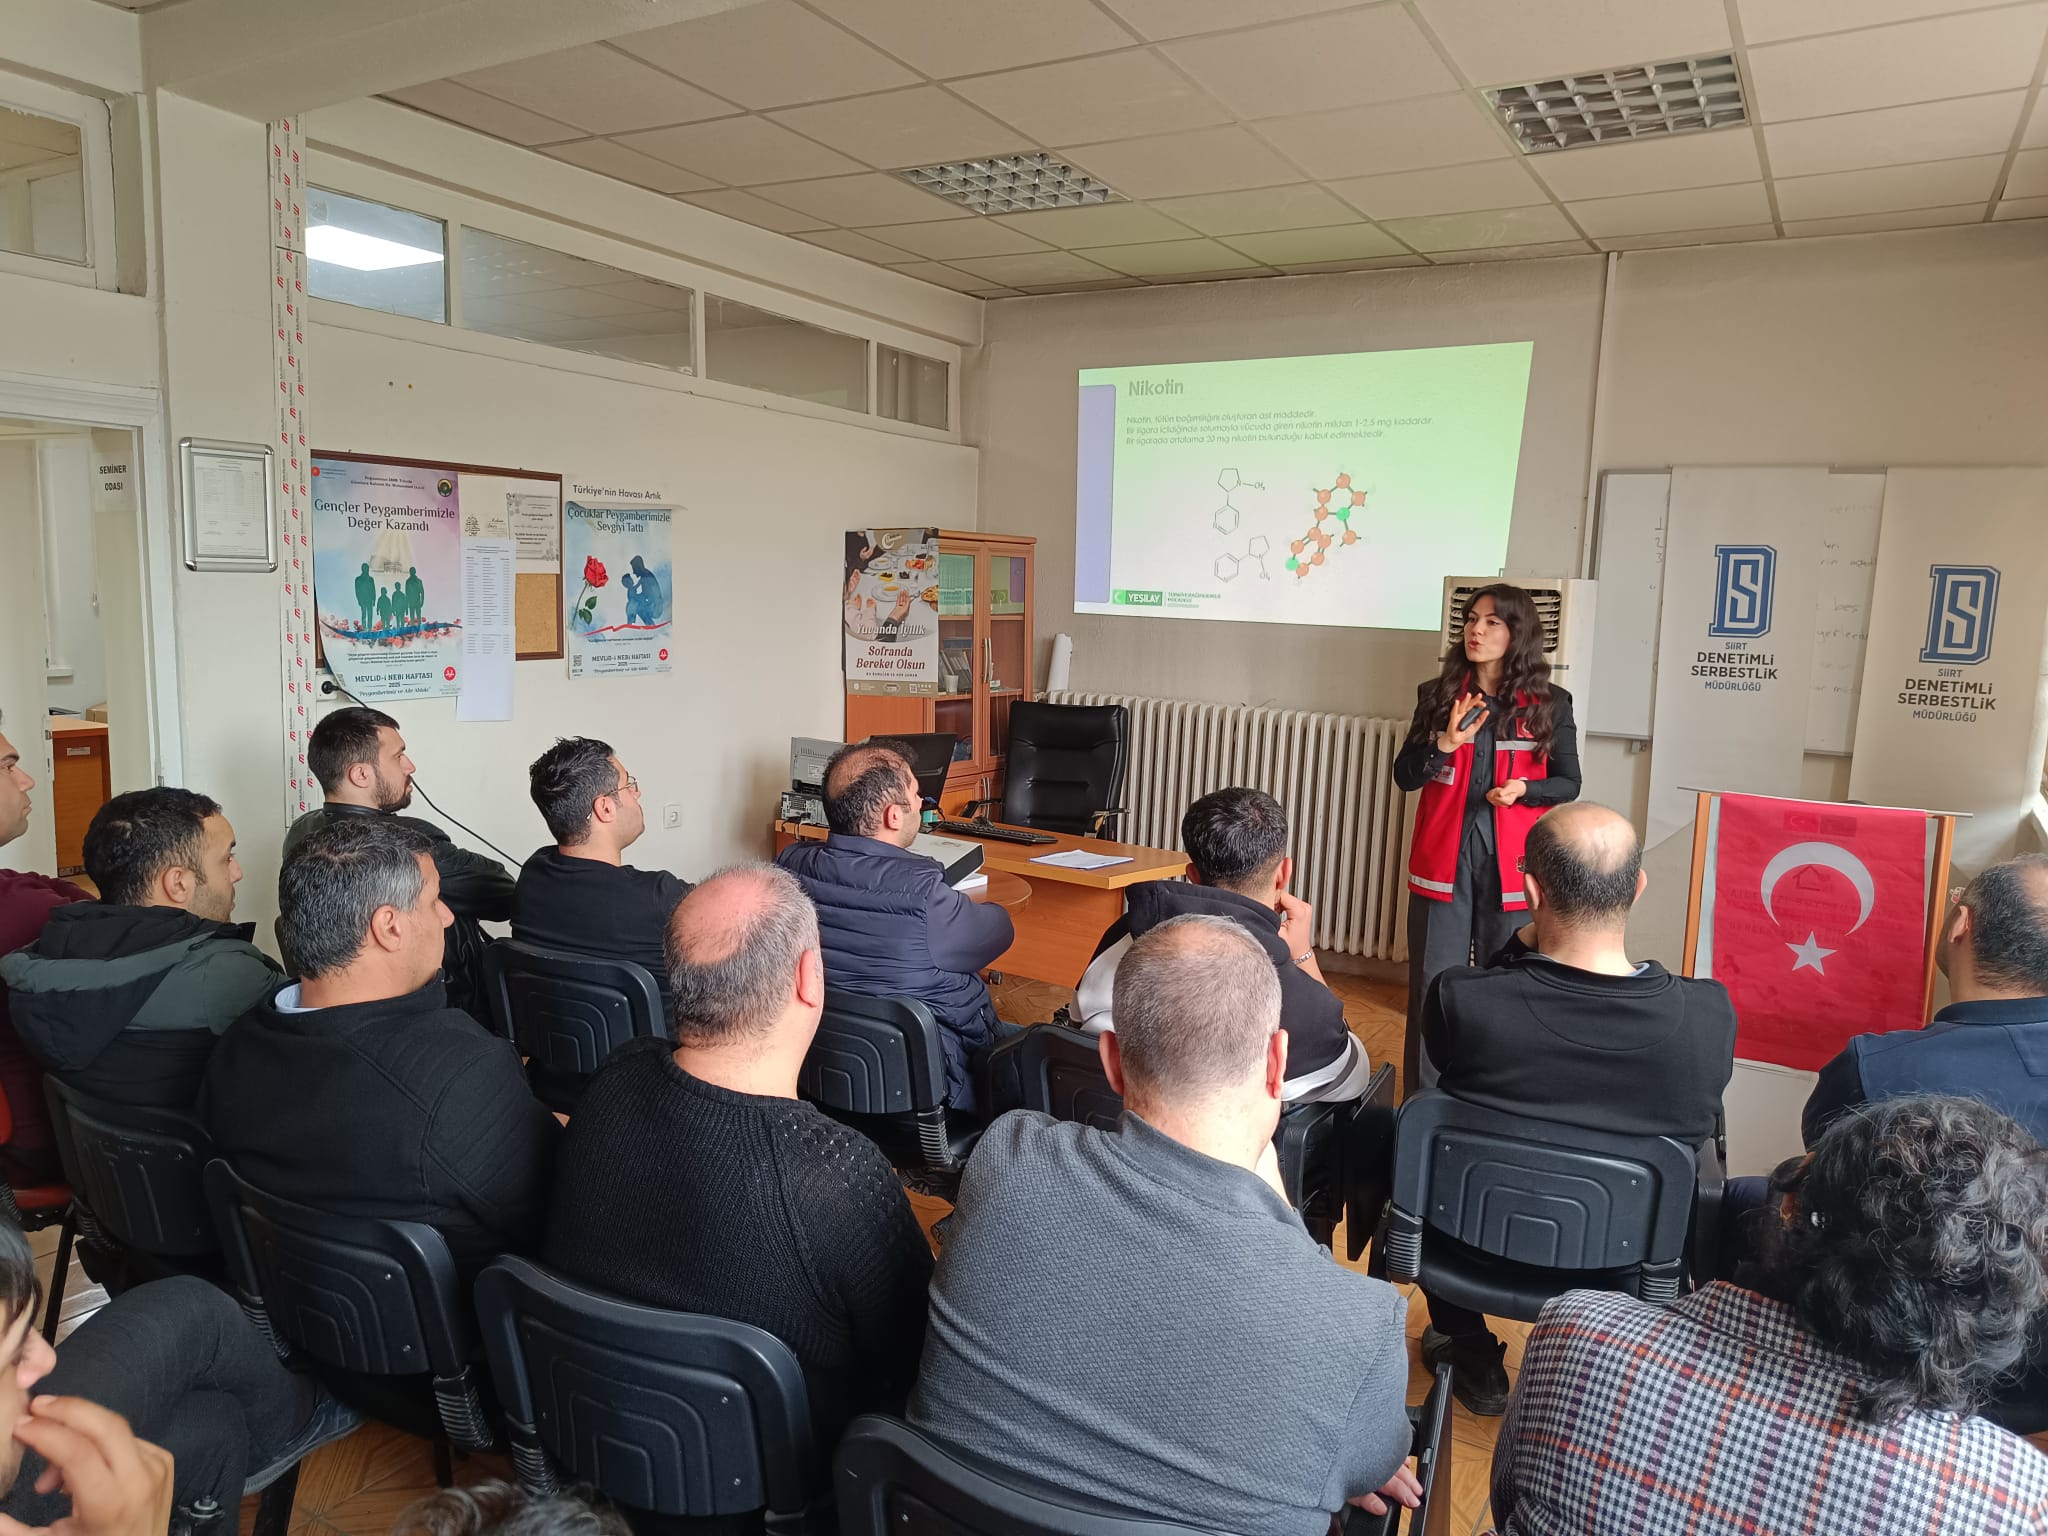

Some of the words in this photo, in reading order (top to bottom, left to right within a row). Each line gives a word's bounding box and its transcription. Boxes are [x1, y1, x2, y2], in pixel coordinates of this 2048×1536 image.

[1129, 379, 1184, 396] Nikotin
[1136, 425, 1159, 436] sigara
[1274, 420, 1293, 432] giren
[1296, 420, 1323, 430] nikotin
[1170, 434, 1204, 445] ortalama
[1232, 431, 1257, 442] nikotin
[1259, 430, 1303, 442] bulunduğu
[99, 463, 127, 474] SEMİNER
[104, 481, 123, 491] ODASI
[572, 484, 617, 497] Türkiye'nin
[618, 488, 643, 500] Havası
[644, 491, 662, 500] Artık
[314, 498, 361, 514] Gençler
[364, 502, 455, 519] Peygamberimizle
[567, 507, 604, 520] Çocuklar
[606, 510, 671, 523] Peygamberimizle
[348, 516, 383, 532] Değer
[386, 518, 429, 532] Kazandı
[597, 521, 625, 534] Sevgiyi
[626, 522, 644, 533] Tattı
[857, 623, 897, 636] Yuvanda
[900, 620, 925, 637] İyilik
[868, 645, 913, 657] Sofranda
[1697, 651, 1774, 666] DENETİMLİ
[856, 657, 894, 669] Bereket
[896, 659, 925, 670] Olsun
[405, 672, 433, 680] HAFTASI
[1691, 665, 1778, 680] SERBESTLİK
[1704, 680, 1762, 692] MÜDÜRLÜĞÜ
[1905, 678, 1993, 695] DENETİMLİ
[1897, 692, 1997, 710] SERBESTLİK
[1912, 709, 1978, 723] MÜDÜRLÜĞÜ
